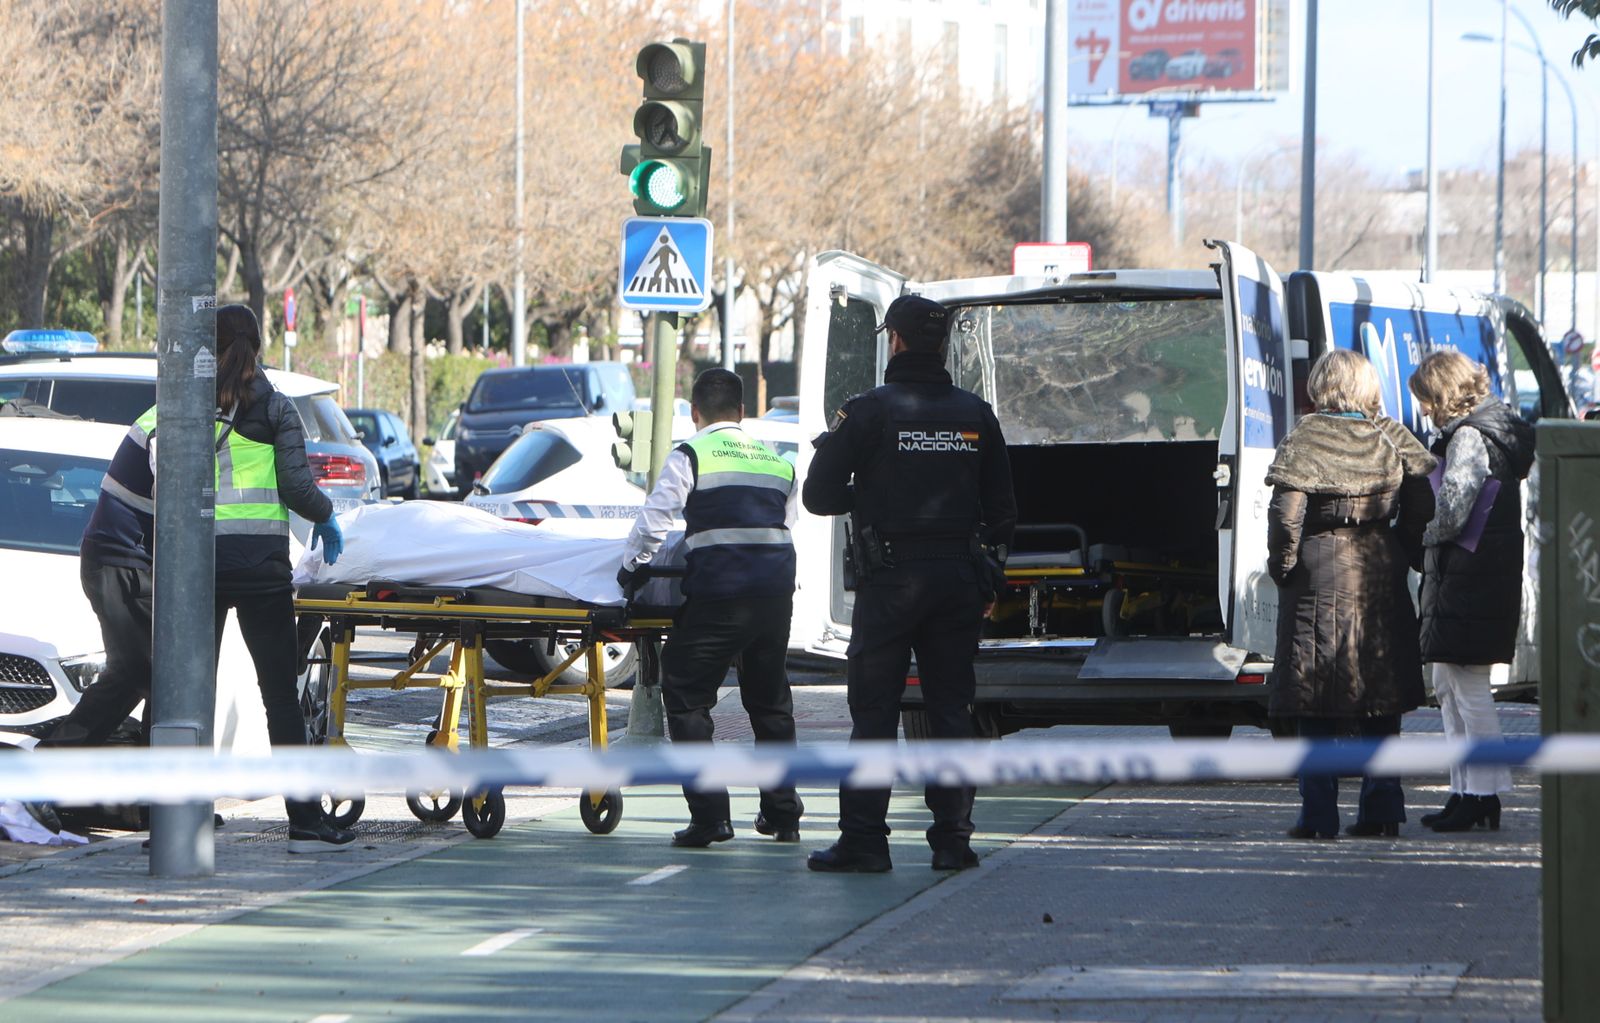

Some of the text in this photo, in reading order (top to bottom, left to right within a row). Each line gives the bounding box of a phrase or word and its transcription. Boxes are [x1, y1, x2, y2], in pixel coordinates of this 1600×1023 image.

[1244, 353, 1284, 397] ervión
[898, 431, 964, 441] POLICIA
[898, 441, 978, 452] NACIONAL
[750, 453, 781, 464] JUDICIAL
